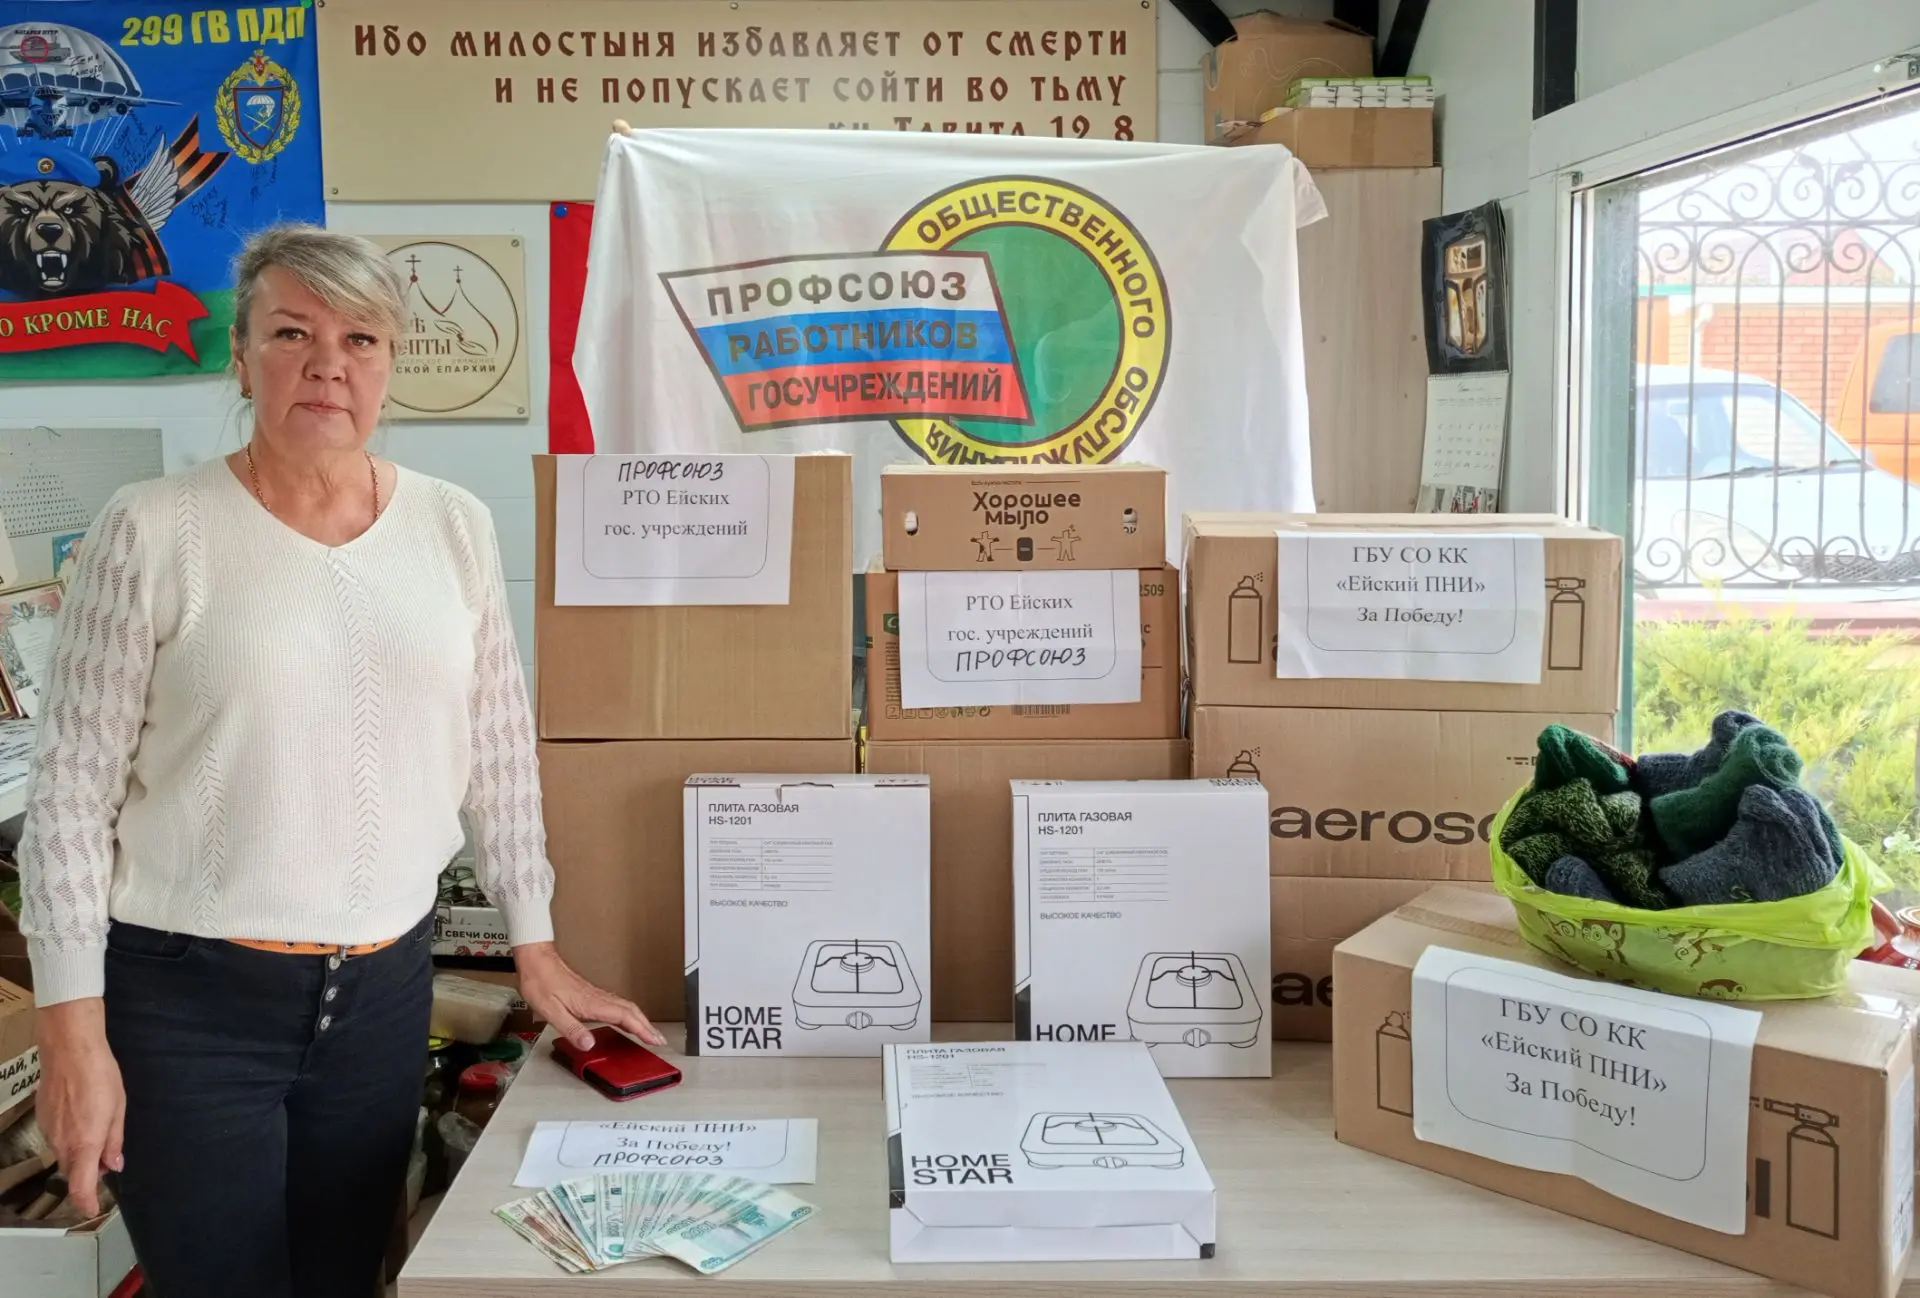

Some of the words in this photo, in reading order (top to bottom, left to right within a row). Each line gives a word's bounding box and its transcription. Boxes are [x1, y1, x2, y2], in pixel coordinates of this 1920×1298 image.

[120, 14, 182, 46] 299
[191, 9, 230, 44] ГВ
[236, 5, 305, 45] ПДП
[916, 190, 1155, 337] ОБЩЕСТВЕННОГО
[706, 268, 967, 317] ПРОФСОЮЗ
[24, 308, 109, 336] КРОМЕ
[121, 307, 172, 338] НАС
[728, 318, 978, 363] РАБОТНИКОВ
[396, 363, 430, 374] СКОЙ
[437, 364, 496, 374] ЕПАРХИИ
[747, 366, 1003, 411] ГОСУЧРЕЖДЕНИЙ
[618, 460, 724, 482] ПРОФСОЮЗ
[623, 489, 661, 505] РТО
[667, 488, 729, 505] Ейских
[972, 491, 1081, 511] Хорошее
[604, 523, 636, 536] гос.
[641, 520, 748, 543] учреждений
[1352, 546, 1394, 563] ГБУ
[1400, 546, 1431, 563] СО
[1439, 547, 1468, 564] КК
[1336, 575, 1418, 592] «Ейский
[1426, 575, 1485, 592] ПНИ»
[966, 594, 1004, 611] РТО
[1010, 593, 1074, 610] Ейских
[1357, 606, 1378, 622] За
[1385, 607, 1463, 627] Победу!
[948, 629, 980, 642] гос.
[986, 624, 1094, 645] учреждений
[956, 647, 1086, 672] ПРОФСОЮЗ
[708, 803, 746, 813] ПЛИТА
[748, 803, 799, 813] ГАЗОВАЯ
[1038, 812, 1076, 822] ПЛИТА
[1079, 811, 1132, 822] ГАЗОВАЯ
[708, 816, 752, 825] HS-1201
[1038, 825, 1084, 835] HS-1201
[445, 930, 480, 939] СВЕЧИ
[483, 931, 508, 941] ОКО
[705, 1006, 782, 1026] HOME
[1501, 998, 1551, 1025] ГБУ
[1560, 1011, 1598, 1037] СО
[1608, 1022, 1648, 1050] КК
[706, 1027, 782, 1050] STAR
[1036, 1024, 1116, 1042] HOME
[1481, 1031, 1582, 1068] «Ейский
[1588, 1052, 1667, 1092] ПНИ»
[11, 1069, 40, 1096] САХА
[1506, 1072, 1532, 1096] За
[1541, 1079, 1636, 1126] Победу!
[616, 1137, 639, 1148] За
[646, 1140, 731, 1153] Победу!
[593, 1151, 724, 1166] ПРОФСОЮЗ
[911, 1154, 1011, 1168] HOME
[912, 1168, 1014, 1185] STAR
